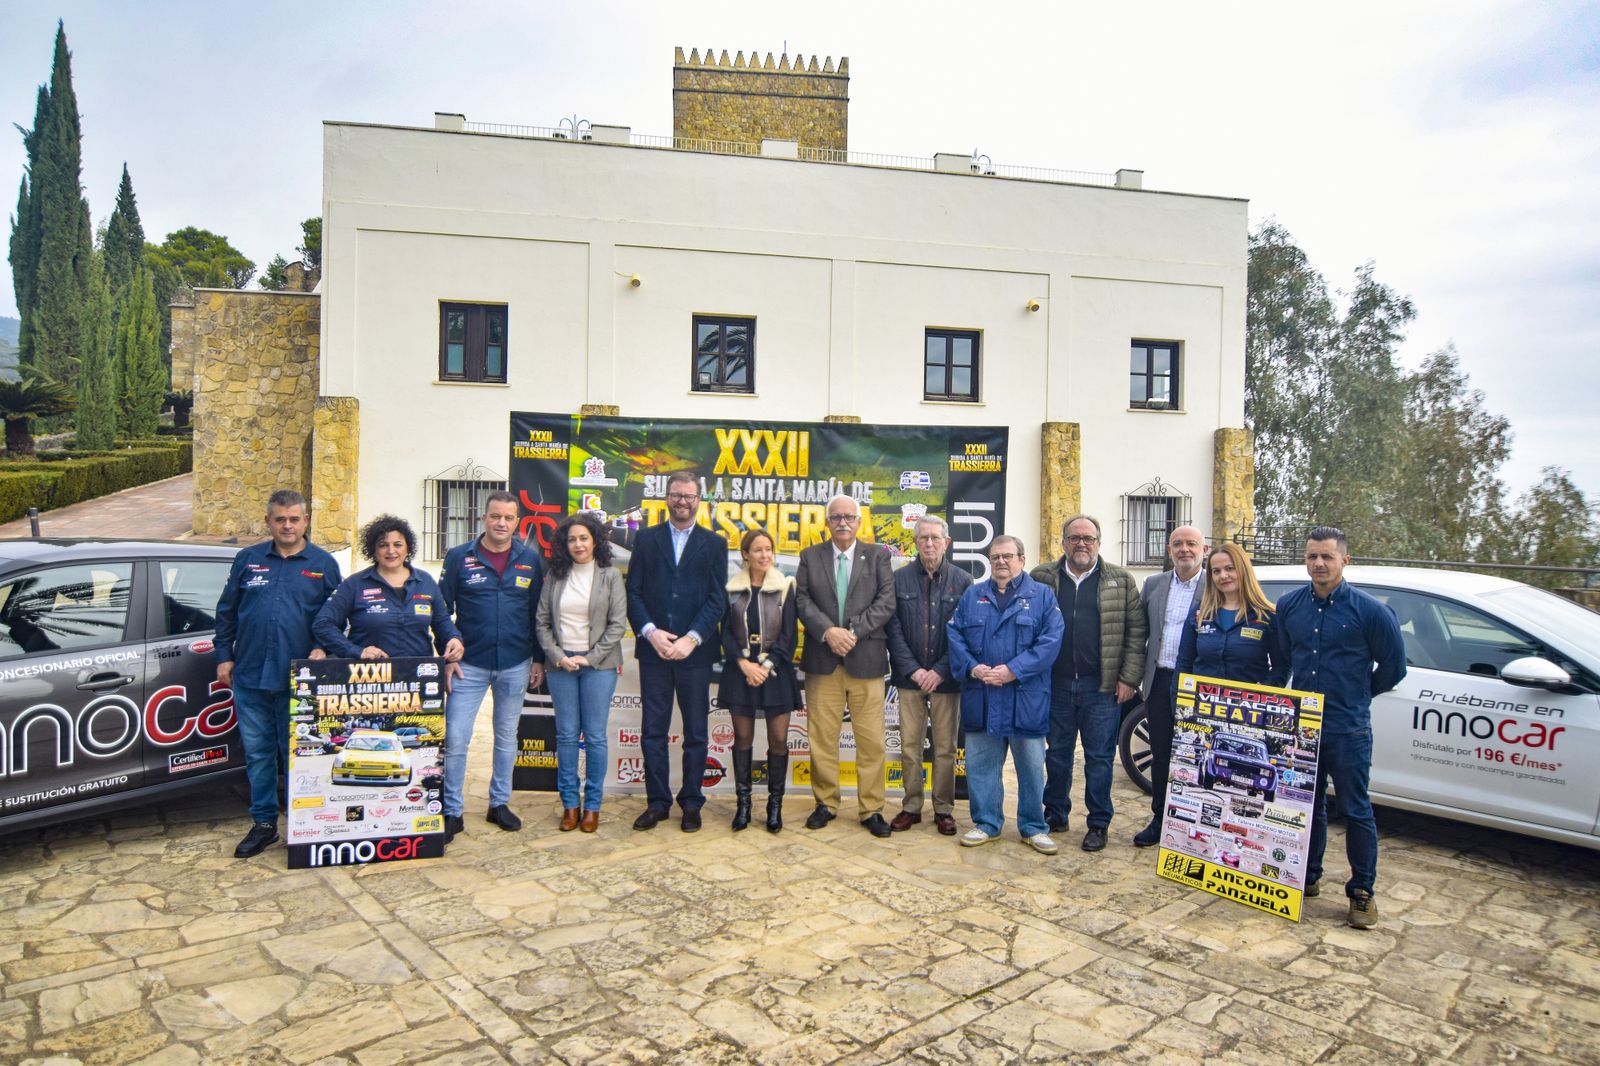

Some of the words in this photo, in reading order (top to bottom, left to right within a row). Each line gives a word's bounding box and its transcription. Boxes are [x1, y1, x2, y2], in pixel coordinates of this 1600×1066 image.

[529, 430, 553, 442] XXXII
[513, 446, 568, 460] TRASSIERRA
[713, 428, 811, 477] XXXII
[965, 443, 987, 455] XXXII
[949, 460, 1001, 472] TRASSIERRA
[643, 474, 708, 498] SUA
[714, 477, 726, 500] A
[731, 477, 785, 501] SANTA
[792, 476, 845, 502] MARÍA
[851, 480, 874, 504] DE
[641, 499, 876, 556] TASSIERA
[95, 650, 141, 664] OFICIAL
[154, 650, 182, 660] LIGIER
[348, 662, 392, 684] XXXII
[317, 684, 347, 695] SUBIDA
[348, 684, 355, 694] A
[356, 683, 382, 694] SANTA
[384, 680, 408, 693] MARÍA
[410, 682, 420, 692] DE
[1199, 684, 1220, 697] VI
[1223, 687, 1296, 709] COPA
[316, 691, 423, 716] TRASSIERRA
[1198, 693, 1295, 716] VILLACOR
[1418, 689, 1529, 713] Pruébame
[1534, 705, 1565, 718] en
[1177, 720, 1213, 734] @Villacor
[1198, 702, 1262, 724] SEAT
[1267, 714, 1295, 732] 124
[1412, 706, 1566, 751] innocar
[523, 739, 545, 751] XXXII
[1412, 739, 1454, 755] Disfrútalo
[1456, 747, 1473, 757] por
[1474, 746, 1505, 763] 196
[1461, 761, 1475, 770] con
[1477, 764, 1514, 777] recompra
[5, 786, 76, 807] SUSTITUCIÓN
[78, 775, 129, 792] GRATUITO
[1255, 824, 1278, 833] MORENO
[1277, 829, 1297, 838] MOTOR
[310, 836, 424, 866] innocar
[1162, 870, 1203, 888] NEUMÁTICOS
